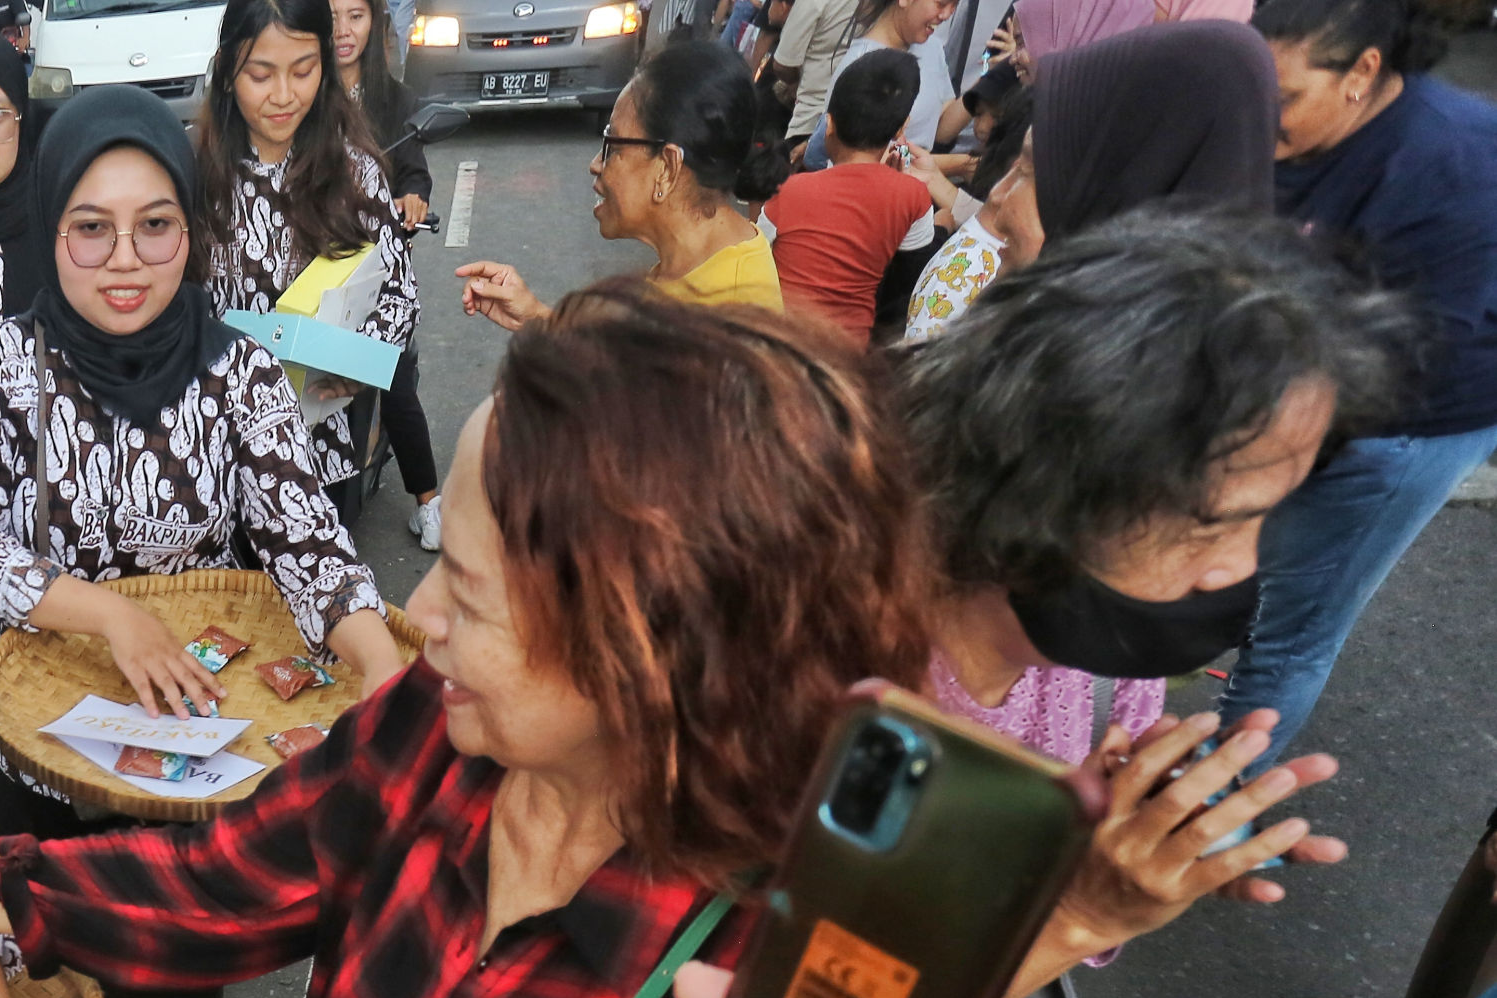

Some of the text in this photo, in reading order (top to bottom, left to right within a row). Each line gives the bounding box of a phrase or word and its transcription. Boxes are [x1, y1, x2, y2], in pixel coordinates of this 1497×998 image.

[484, 73, 548, 89] AB 8227 EU
[74, 715, 220, 742] BAKPIAKU
